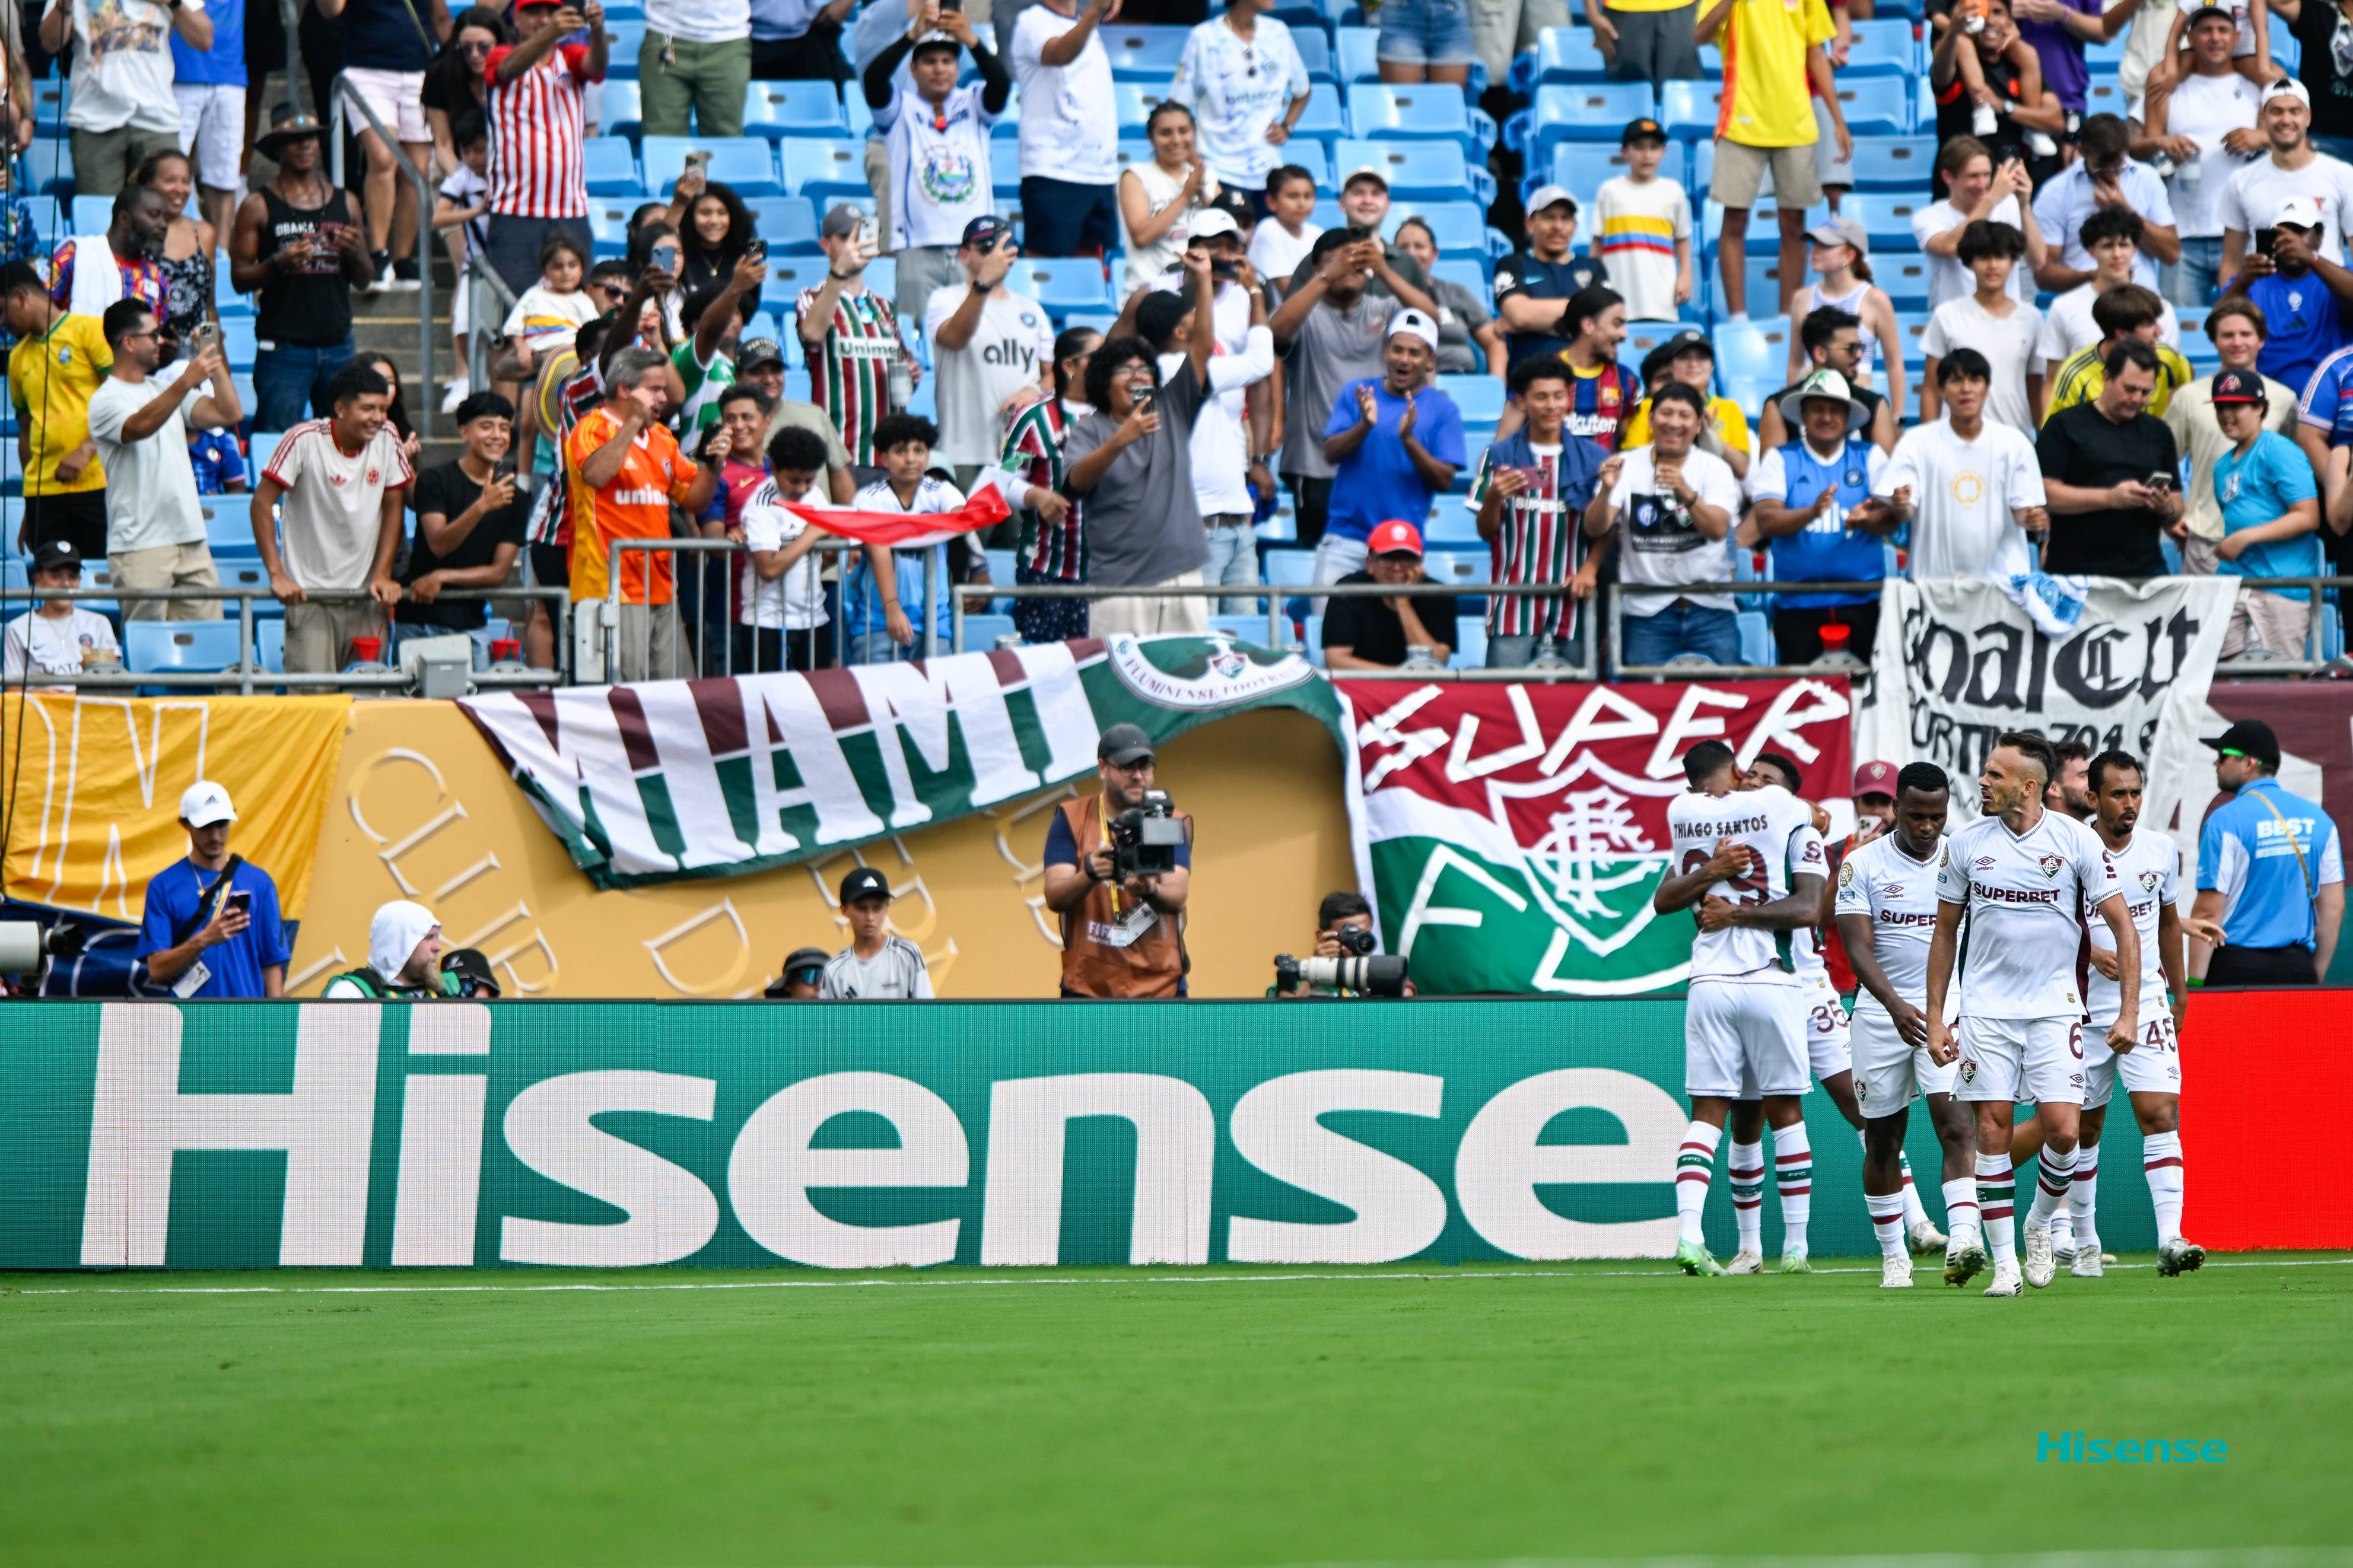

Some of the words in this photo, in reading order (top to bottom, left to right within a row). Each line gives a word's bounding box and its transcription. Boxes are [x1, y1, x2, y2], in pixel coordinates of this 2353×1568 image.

[983, 338, 1035, 374] ally
[1358, 678, 1850, 794] SUPER
[459, 641, 1099, 874] MIAMI
[1674, 822, 1712, 839] THIAGO
[1717, 815, 1769, 836] SANTOS
[2257, 818, 2316, 839] BEST
[1974, 882, 2061, 903] SUPERBET
[1811, 1000, 1849, 1033] 35
[2069, 1022, 2084, 1060] 6
[2145, 1018, 2177, 1053] 45
[80, 1003, 1691, 1265] Hisense
